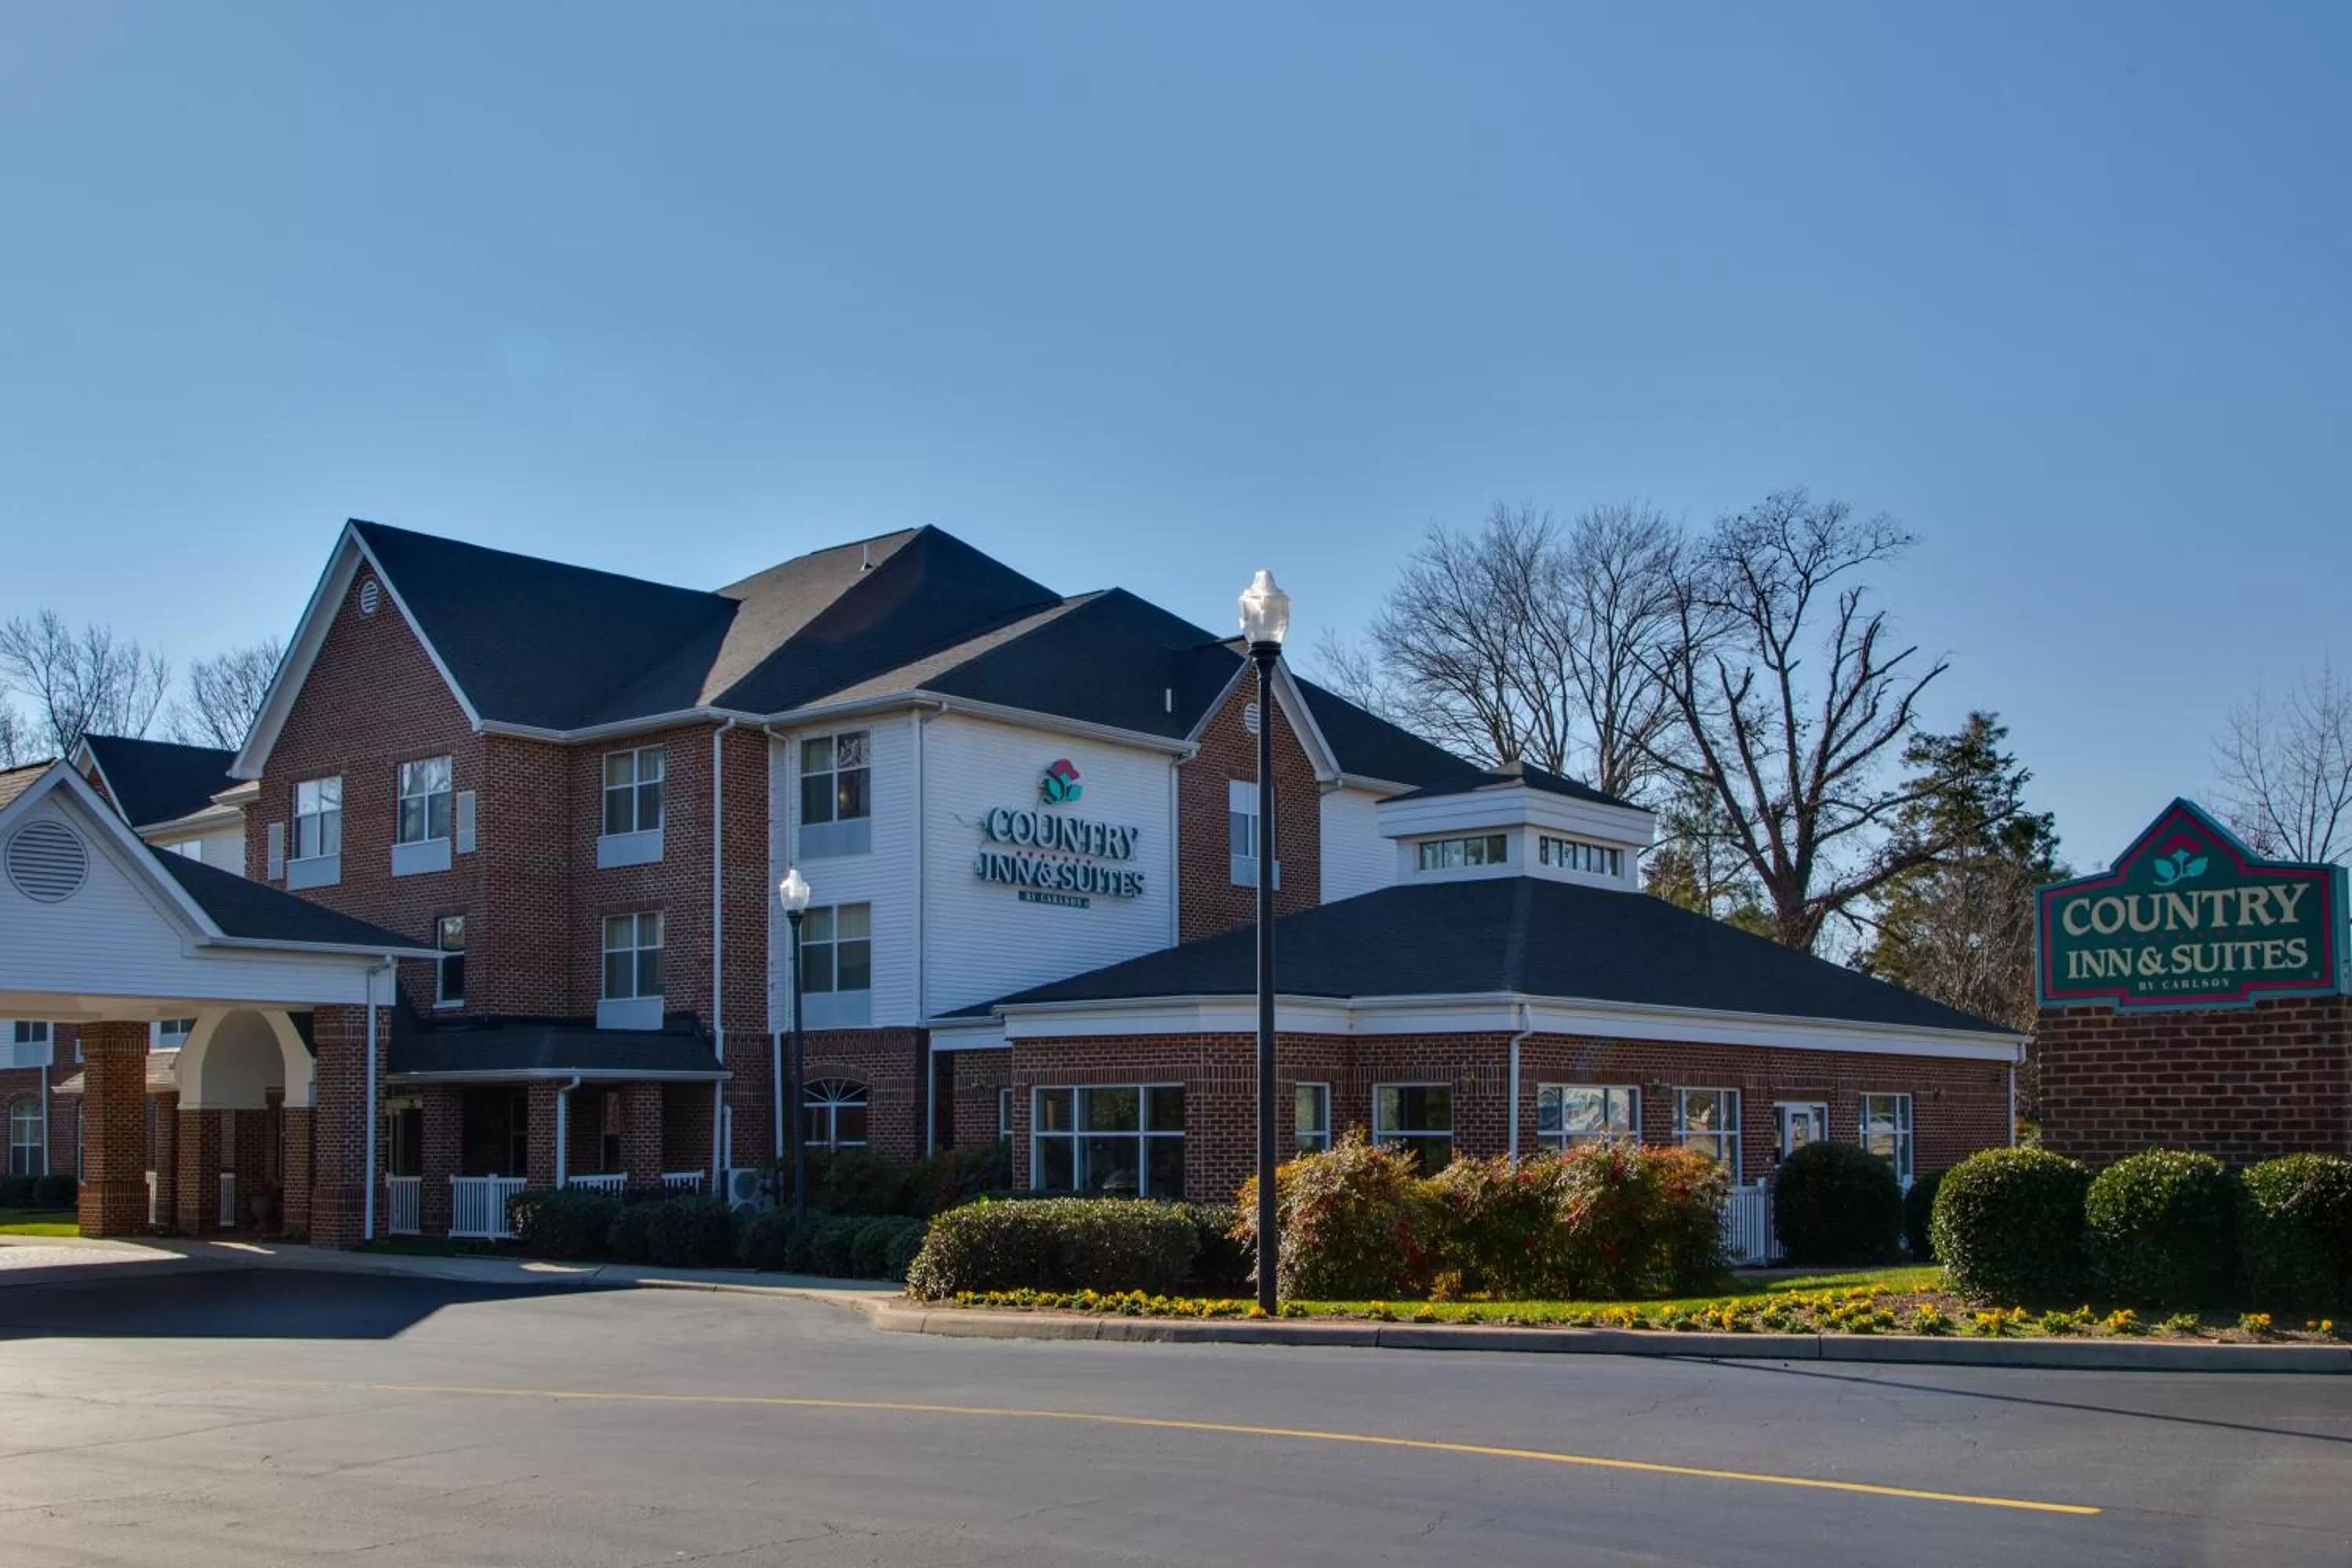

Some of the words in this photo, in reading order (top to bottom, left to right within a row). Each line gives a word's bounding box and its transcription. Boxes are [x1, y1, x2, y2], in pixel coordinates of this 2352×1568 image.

[987, 807, 1138, 860] COUNTRY
[2062, 883, 2310, 936] COUNTRY
[2138, 980, 2154, 992] BY
